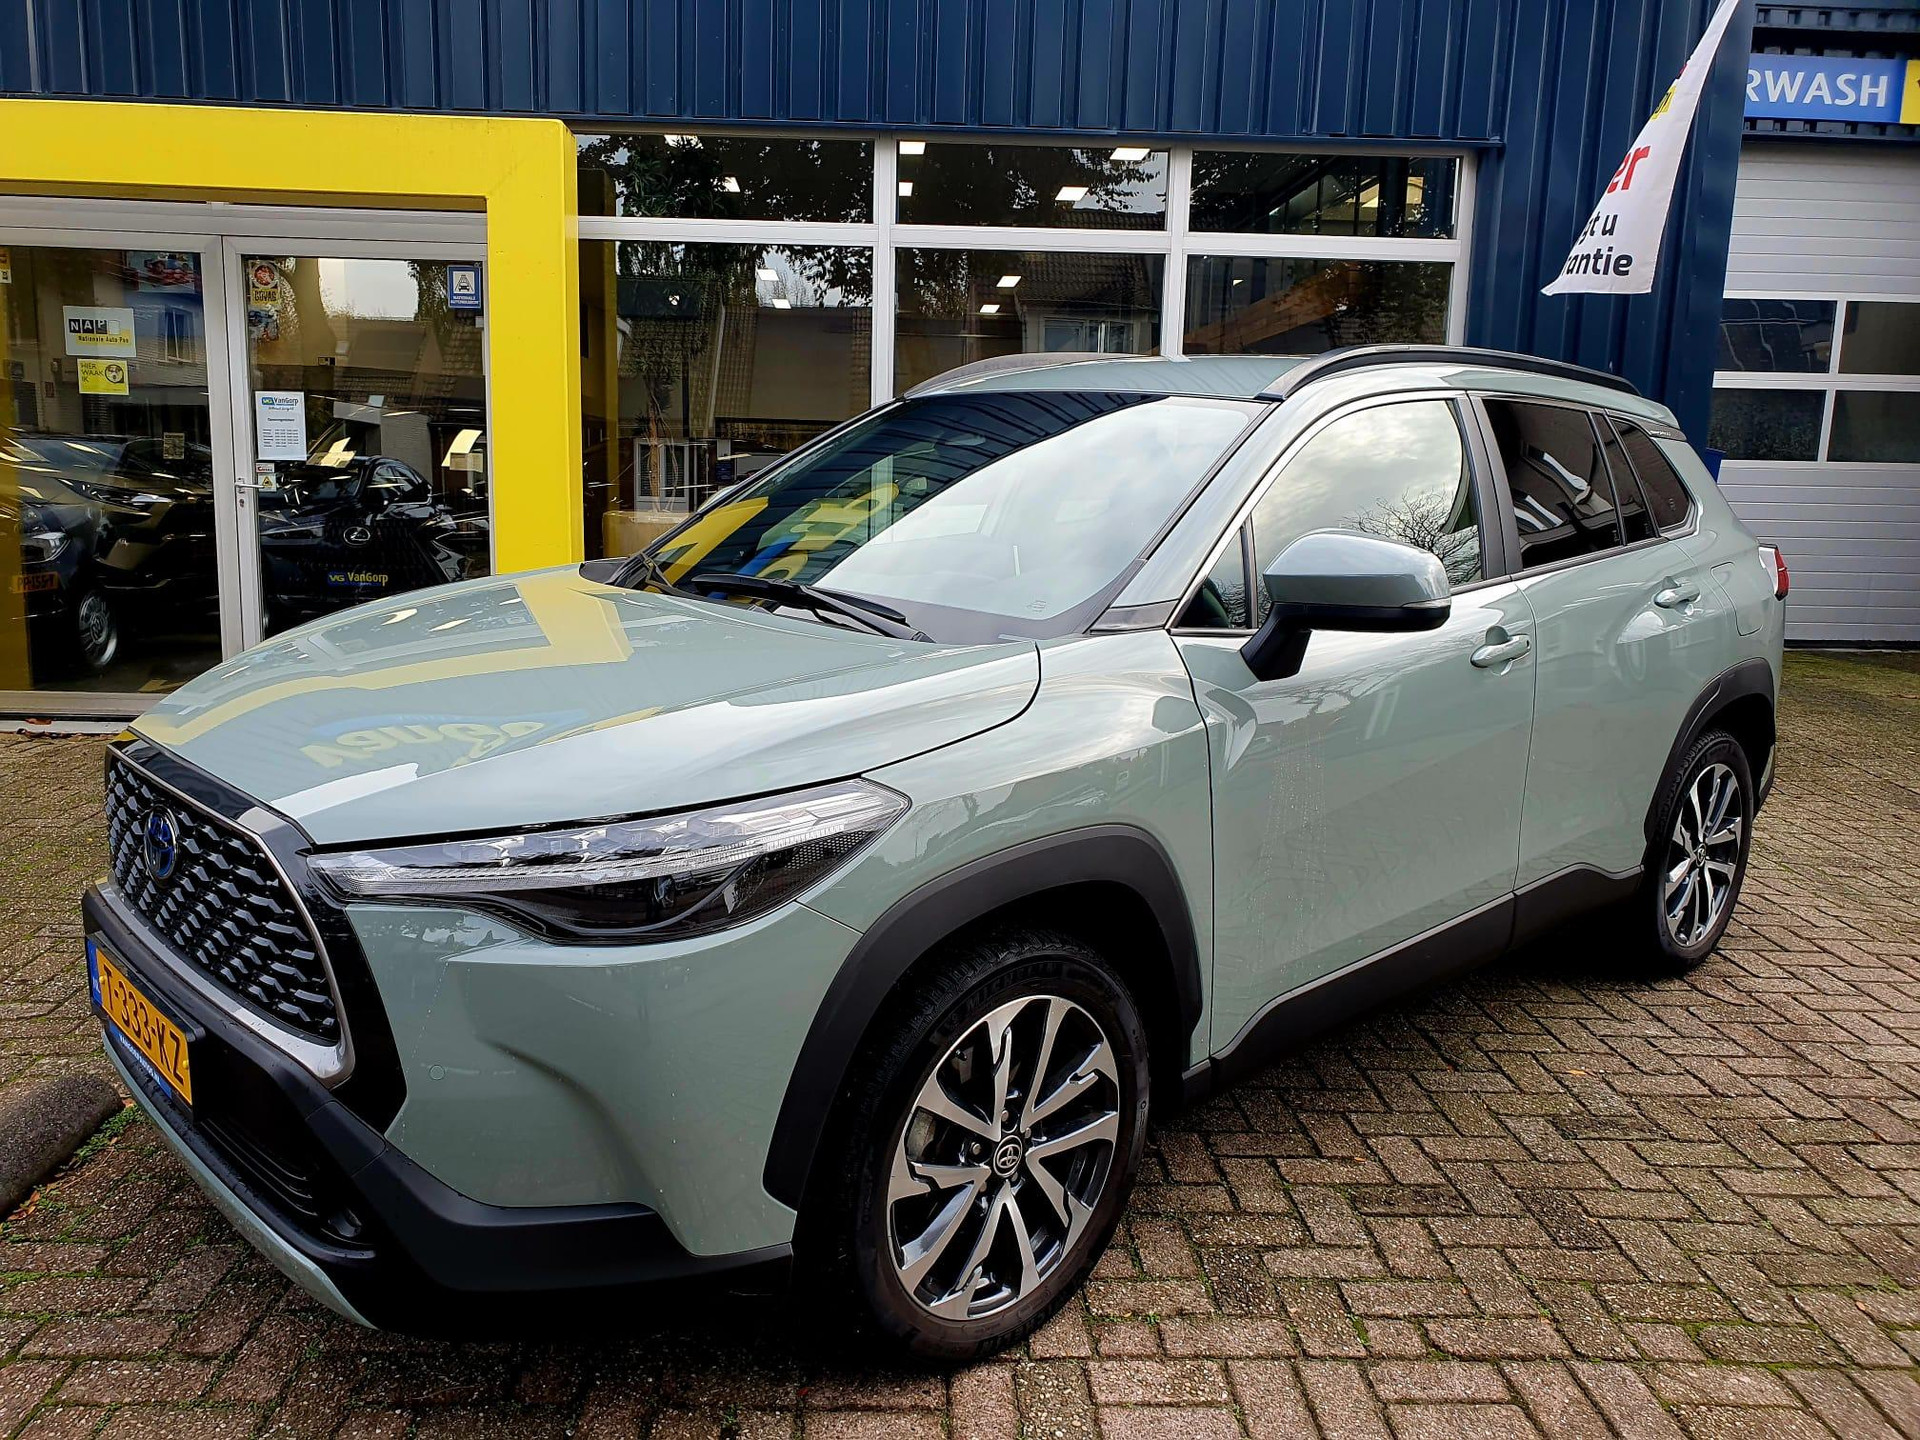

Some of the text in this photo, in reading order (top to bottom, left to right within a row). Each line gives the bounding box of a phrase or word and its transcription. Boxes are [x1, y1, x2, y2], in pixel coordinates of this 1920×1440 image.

[1745, 68, 1889, 108] RWASH
[1601, 214, 1618, 236] u
[69, 319, 107, 333] NAP
[80, 362, 97, 370] HIER
[81, 369, 104, 377] WAAK
[81, 376, 89, 384] IK
[347, 571, 389, 587] VanGorp
